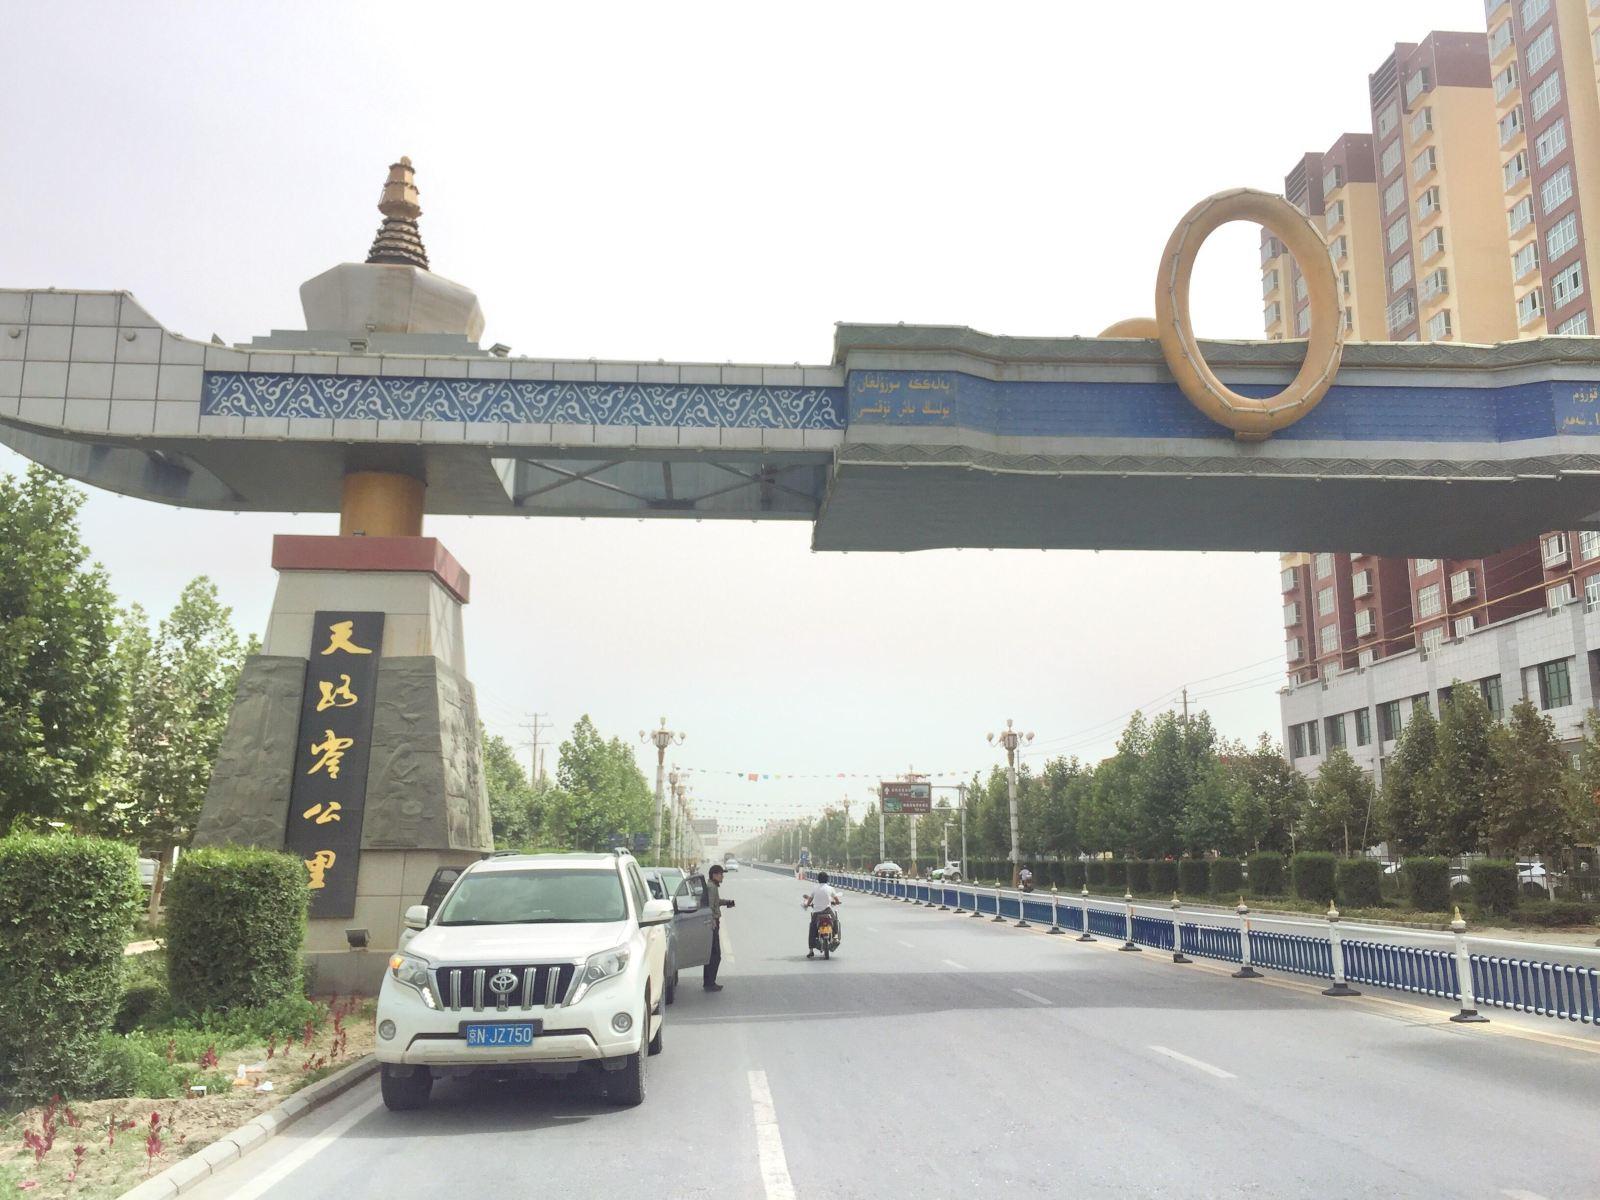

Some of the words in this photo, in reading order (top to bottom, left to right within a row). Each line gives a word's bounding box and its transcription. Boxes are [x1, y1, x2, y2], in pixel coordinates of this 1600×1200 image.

[303, 620, 373, 889] 天路零公里
